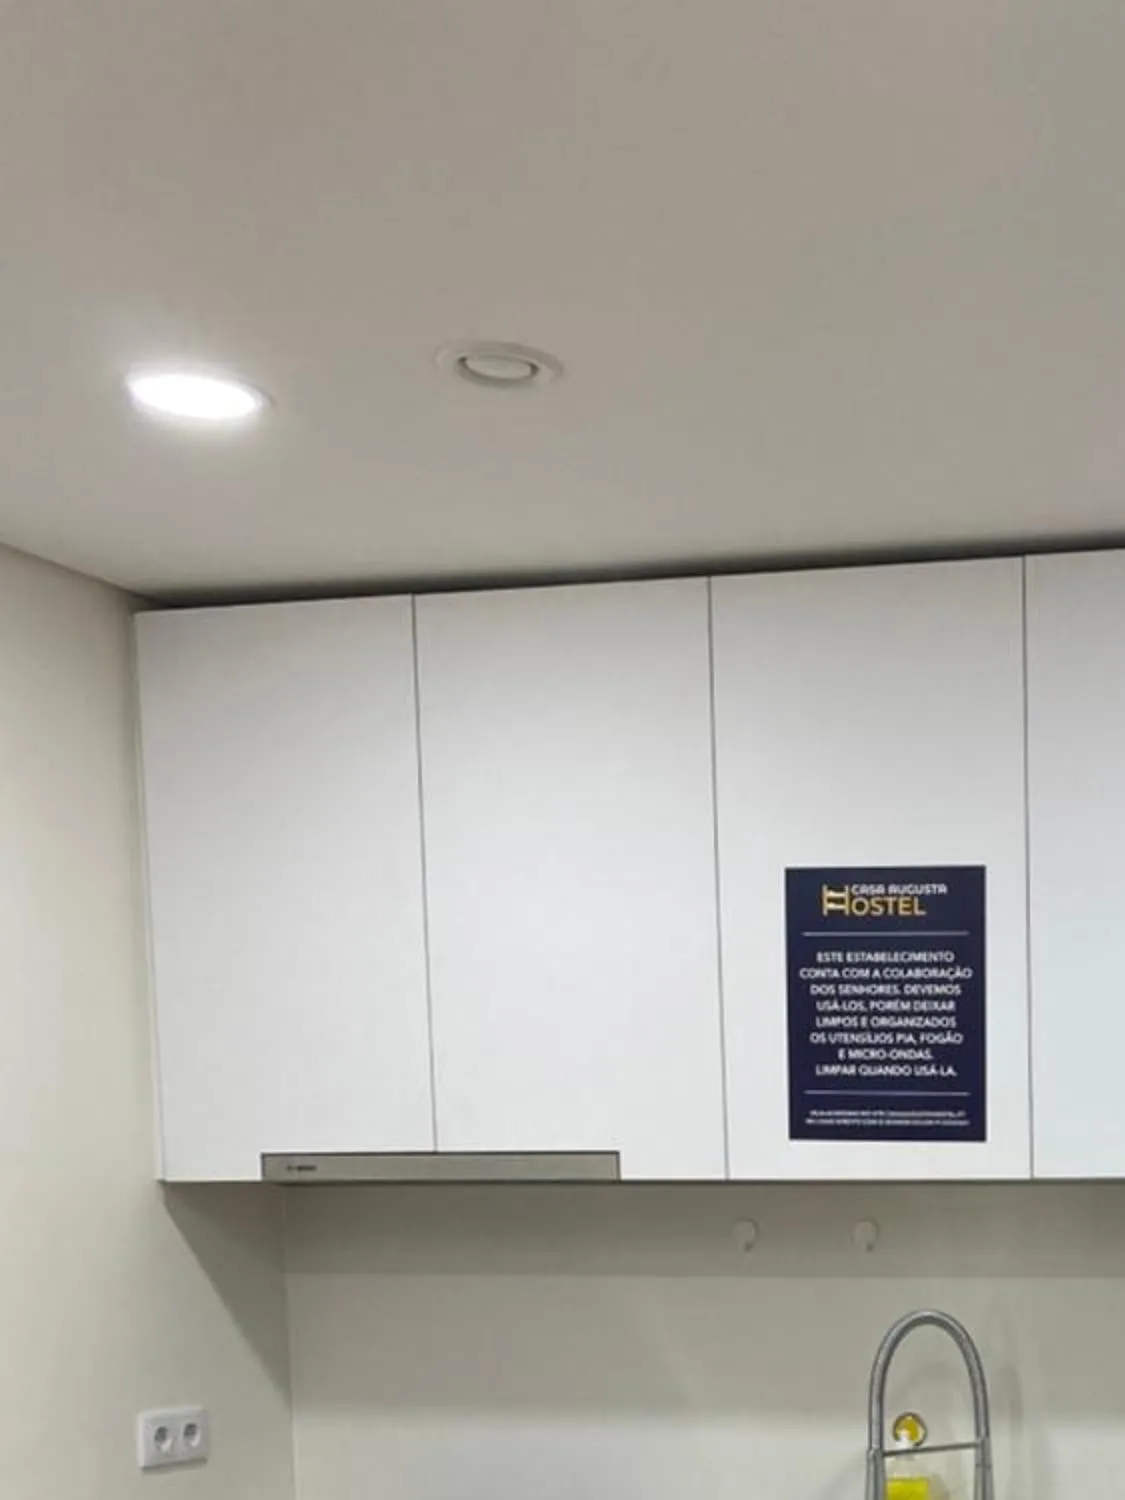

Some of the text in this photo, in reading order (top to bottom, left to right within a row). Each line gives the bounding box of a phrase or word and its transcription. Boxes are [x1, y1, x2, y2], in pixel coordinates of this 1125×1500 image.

[851, 883, 948, 895] CASA AUGUSTA
[822, 884, 928, 916] HOSTEL
[816, 951, 955, 963] ESTE ESTABELECIMENTO
[799, 965, 974, 980] CONTA COM A COLABORAÇÃO
[810, 984, 836, 995] DOS
[903, 984, 962, 995] DEVEMOS
[869, 999, 911, 1012] PORÉM
[913, 1000, 956, 1012] DEIXAR
[816, 1016, 957, 1028] LIMPOS E ORGANIZADOS
[809, 1032, 827, 1044] OS
[919, 1030, 964, 1044] FOGÃO
[838, 1048, 846, 1060] E
[816, 1064, 856, 1076] LIMPAR
[858, 1064, 912, 1076] QUANDO
